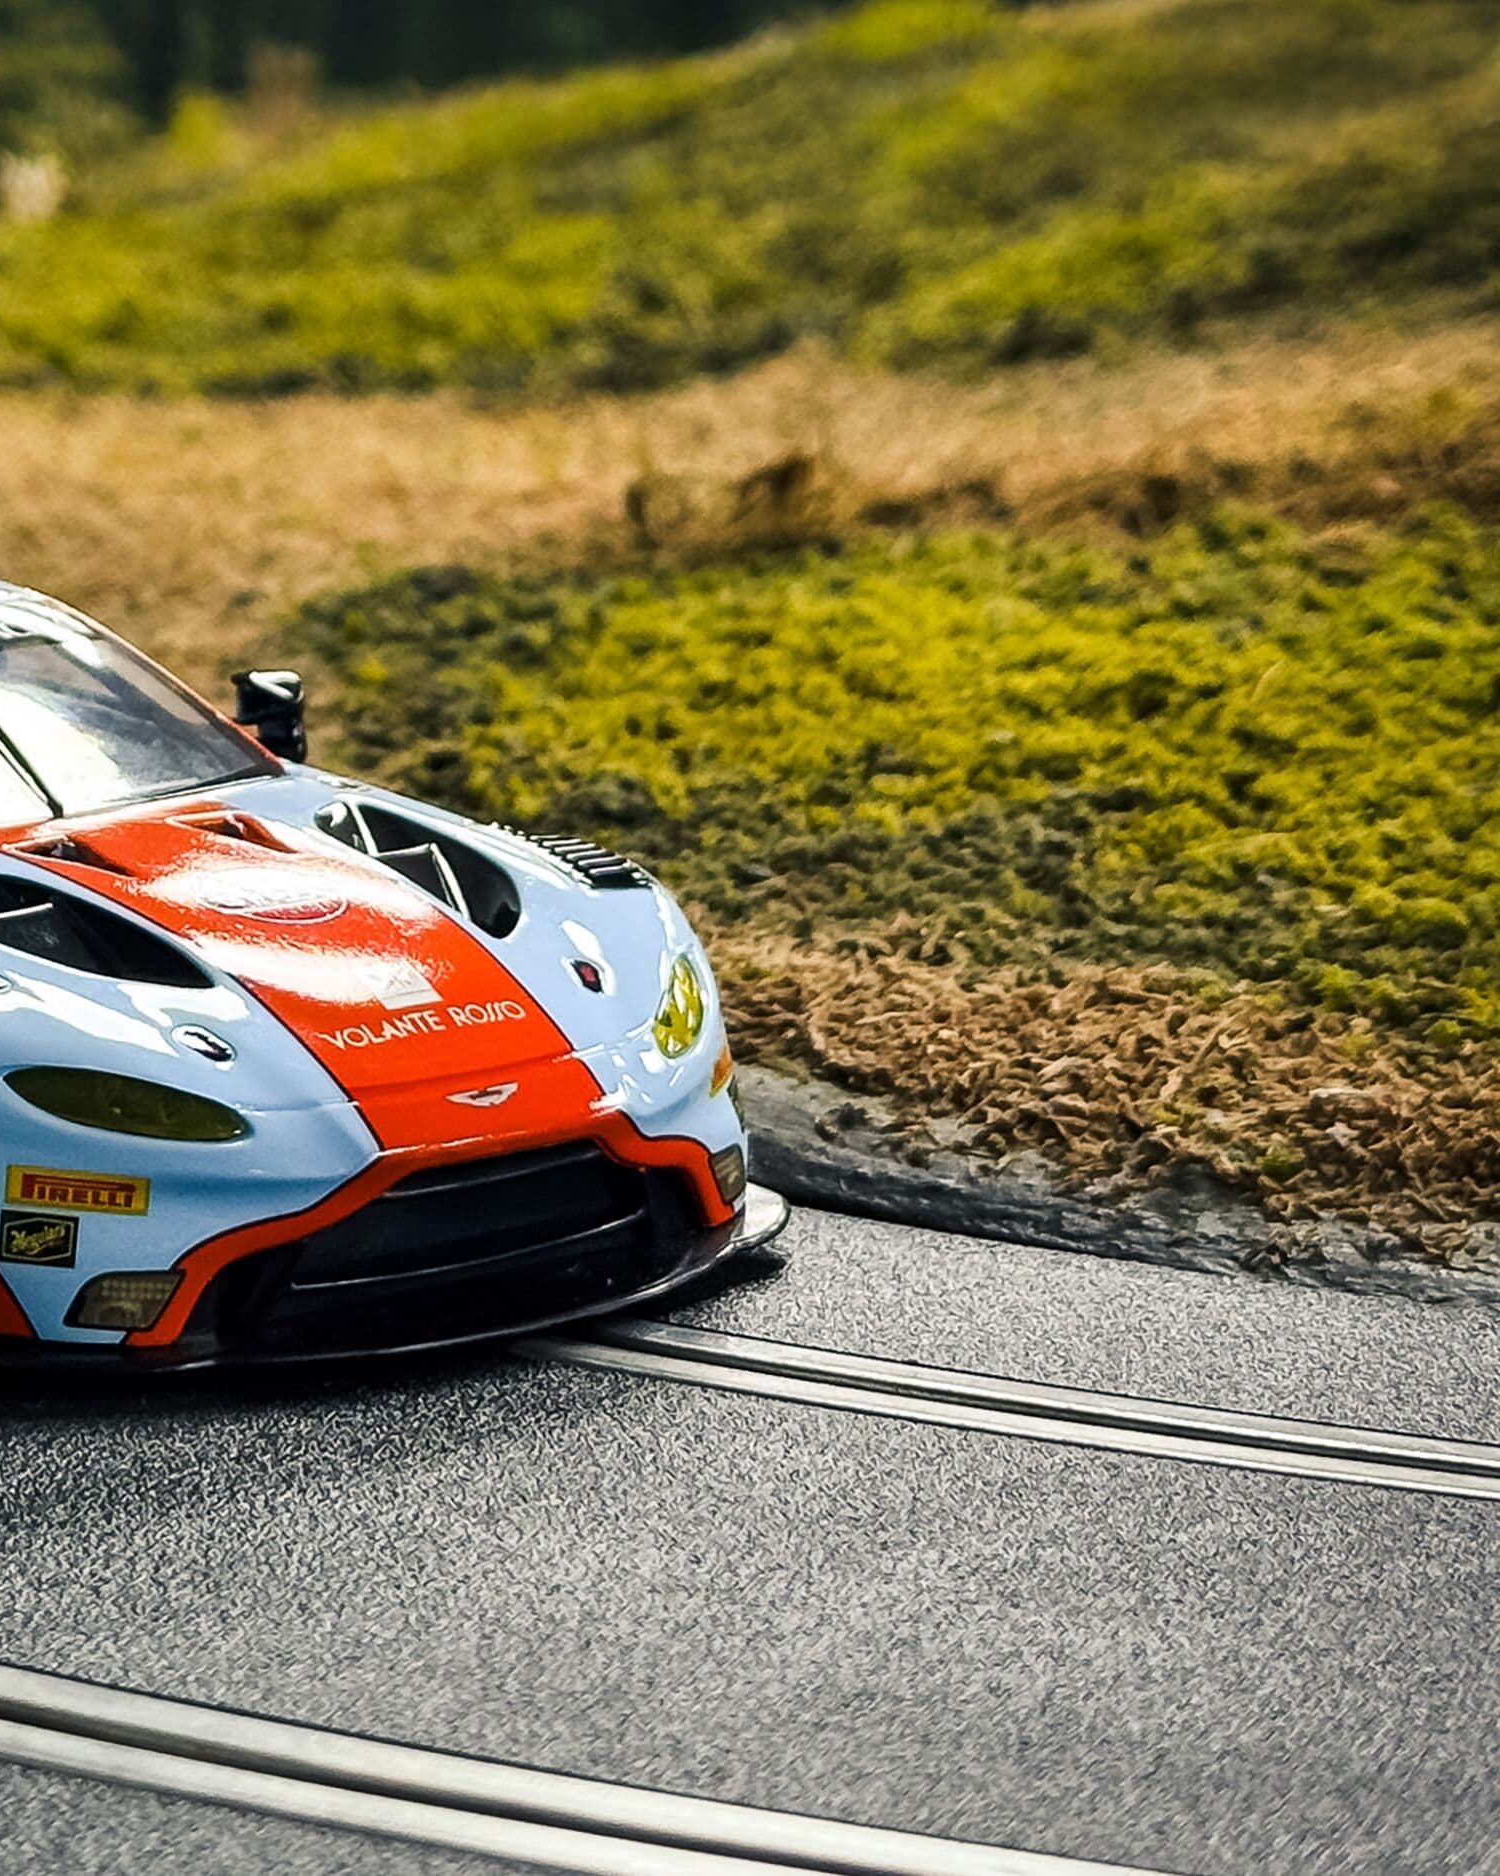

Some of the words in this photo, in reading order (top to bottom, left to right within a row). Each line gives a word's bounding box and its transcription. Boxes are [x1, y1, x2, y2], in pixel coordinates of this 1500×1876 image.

[314, 1009, 447, 1050] VOLANTE
[447, 1000, 527, 1028] ROSSO
[20, 1172, 137, 1209] PIRELLI
